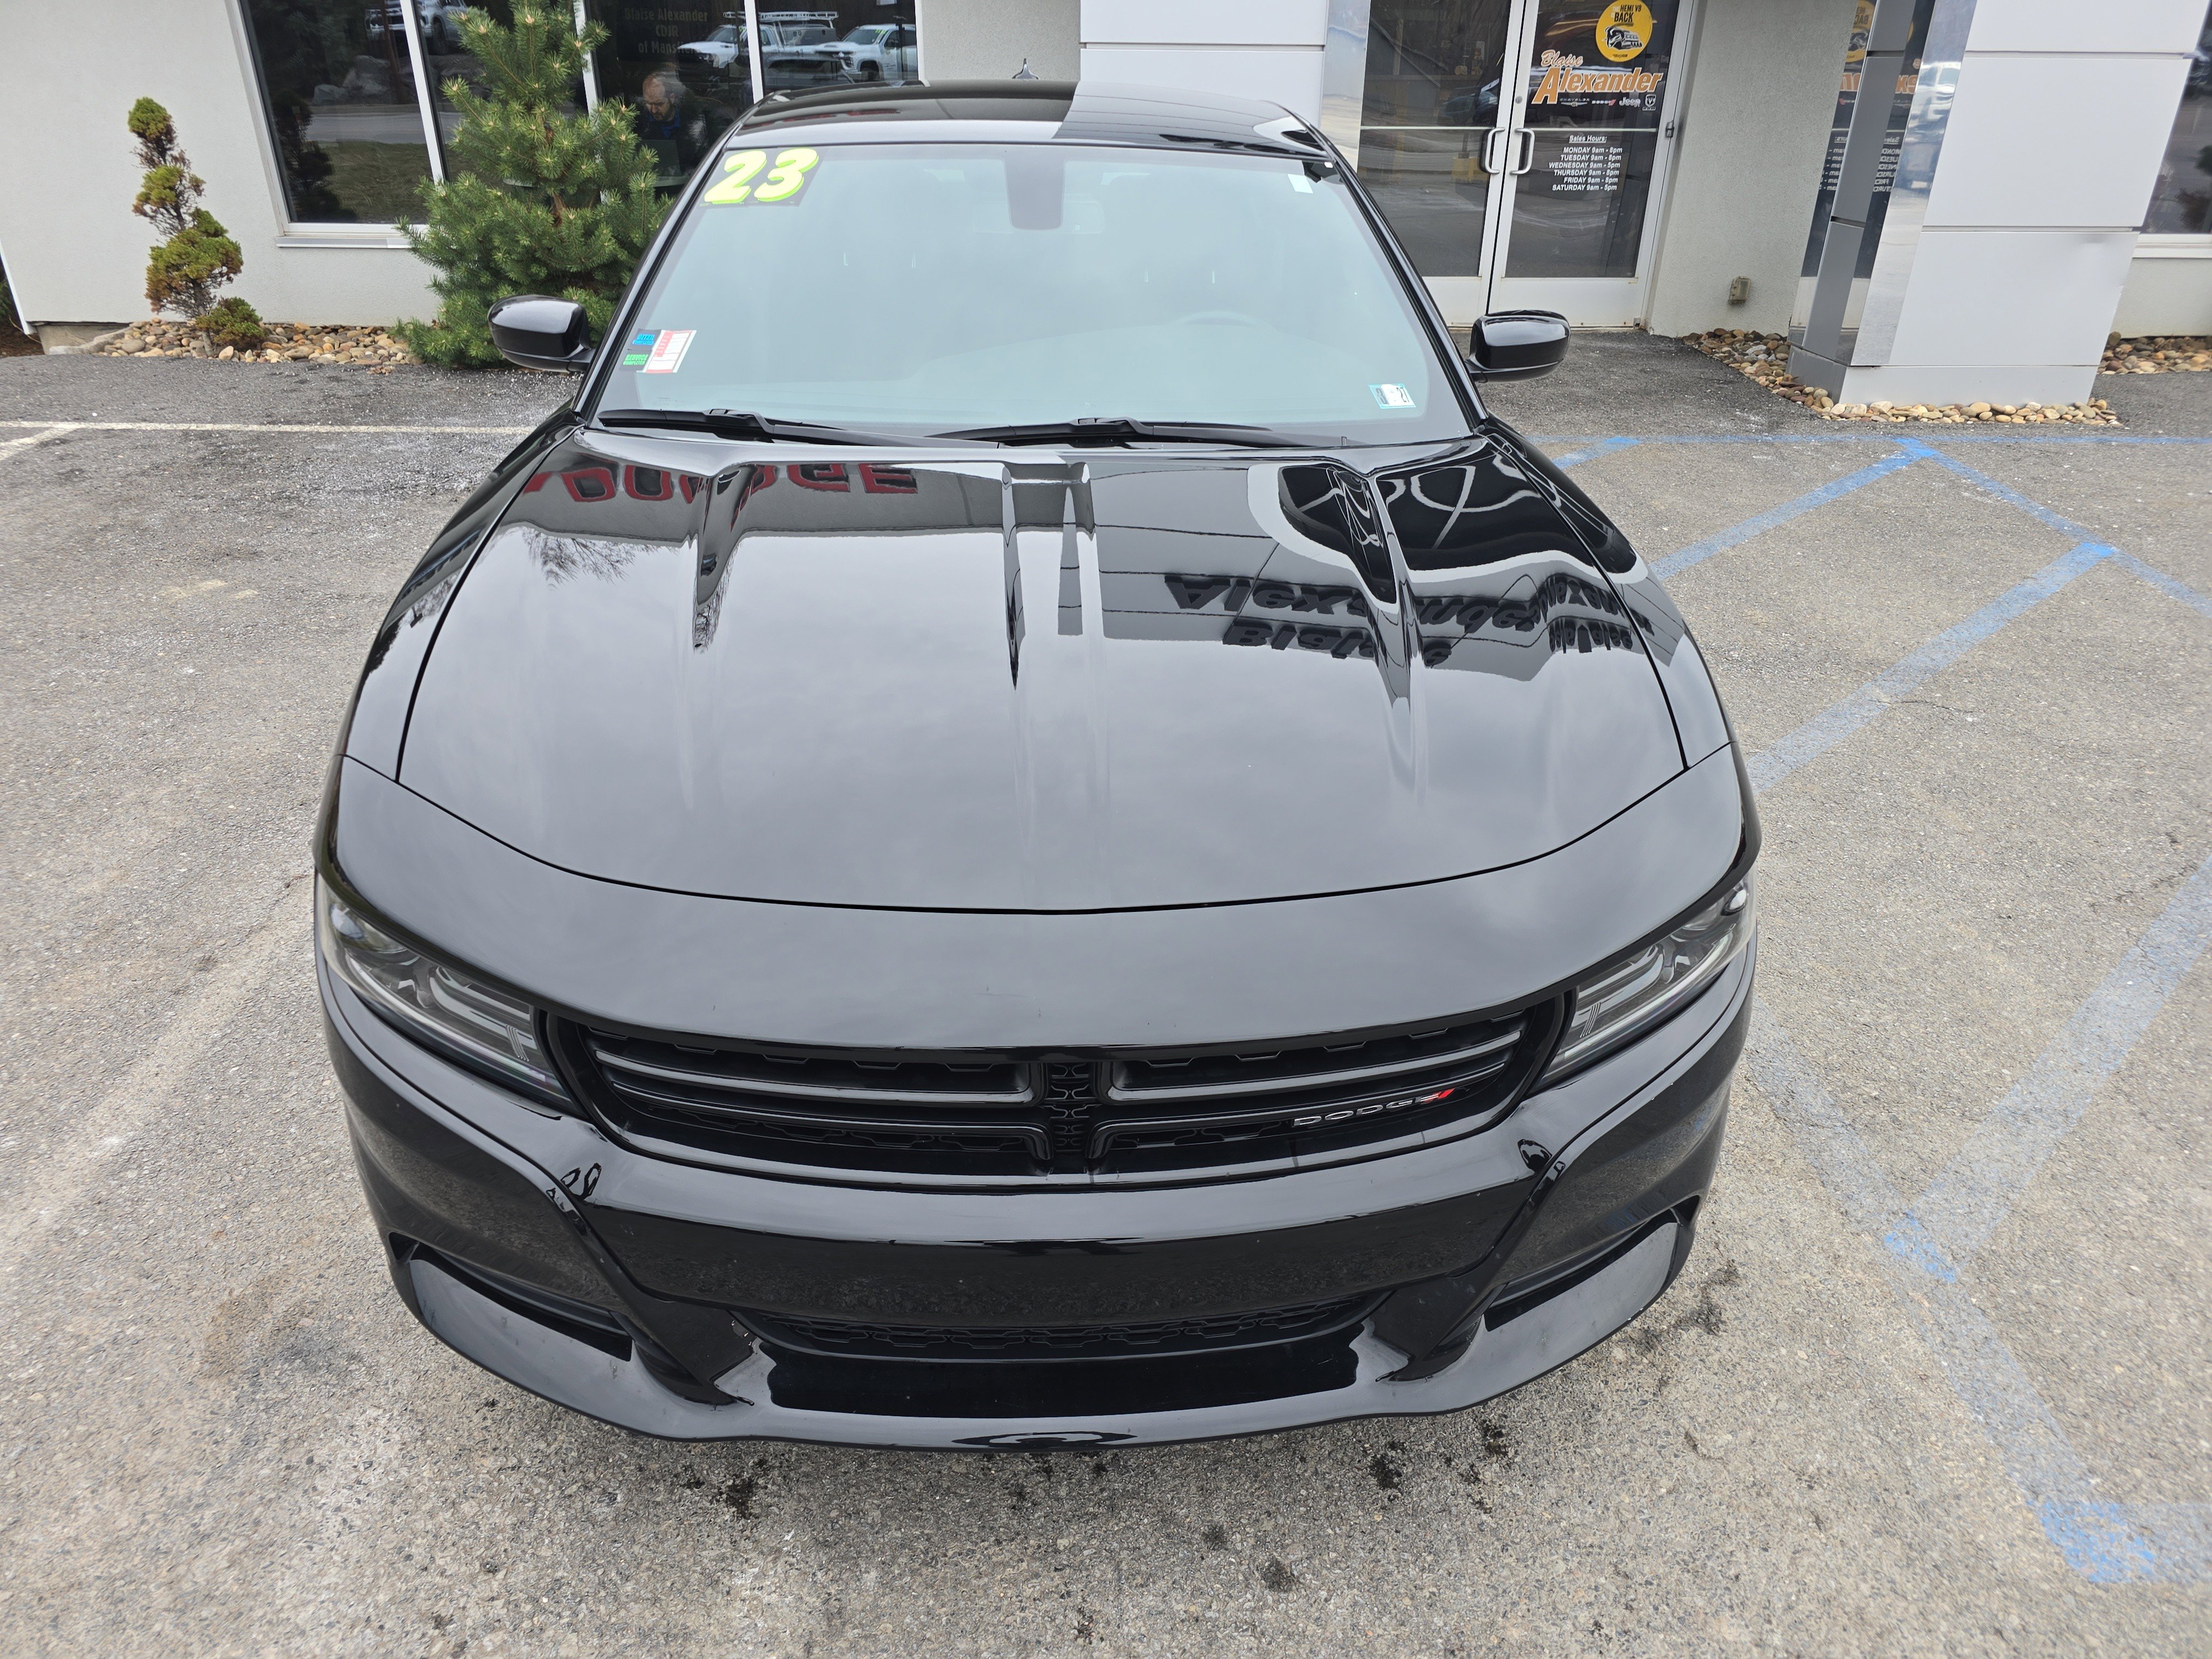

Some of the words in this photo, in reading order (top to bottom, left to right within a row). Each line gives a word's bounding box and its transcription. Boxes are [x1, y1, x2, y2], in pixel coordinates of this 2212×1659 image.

[658, 8, 708, 22] Alexander
[1614, 12, 1634, 22] BACK
[638, 41, 648, 53] of
[1541, 49, 1583, 67] Blaise
[1531, 67, 1663, 104] Alexander
[1619, 97, 1641, 107] Jeep
[704, 148, 819, 204] 23
[1293, 1092, 1440, 1127] DODGE
